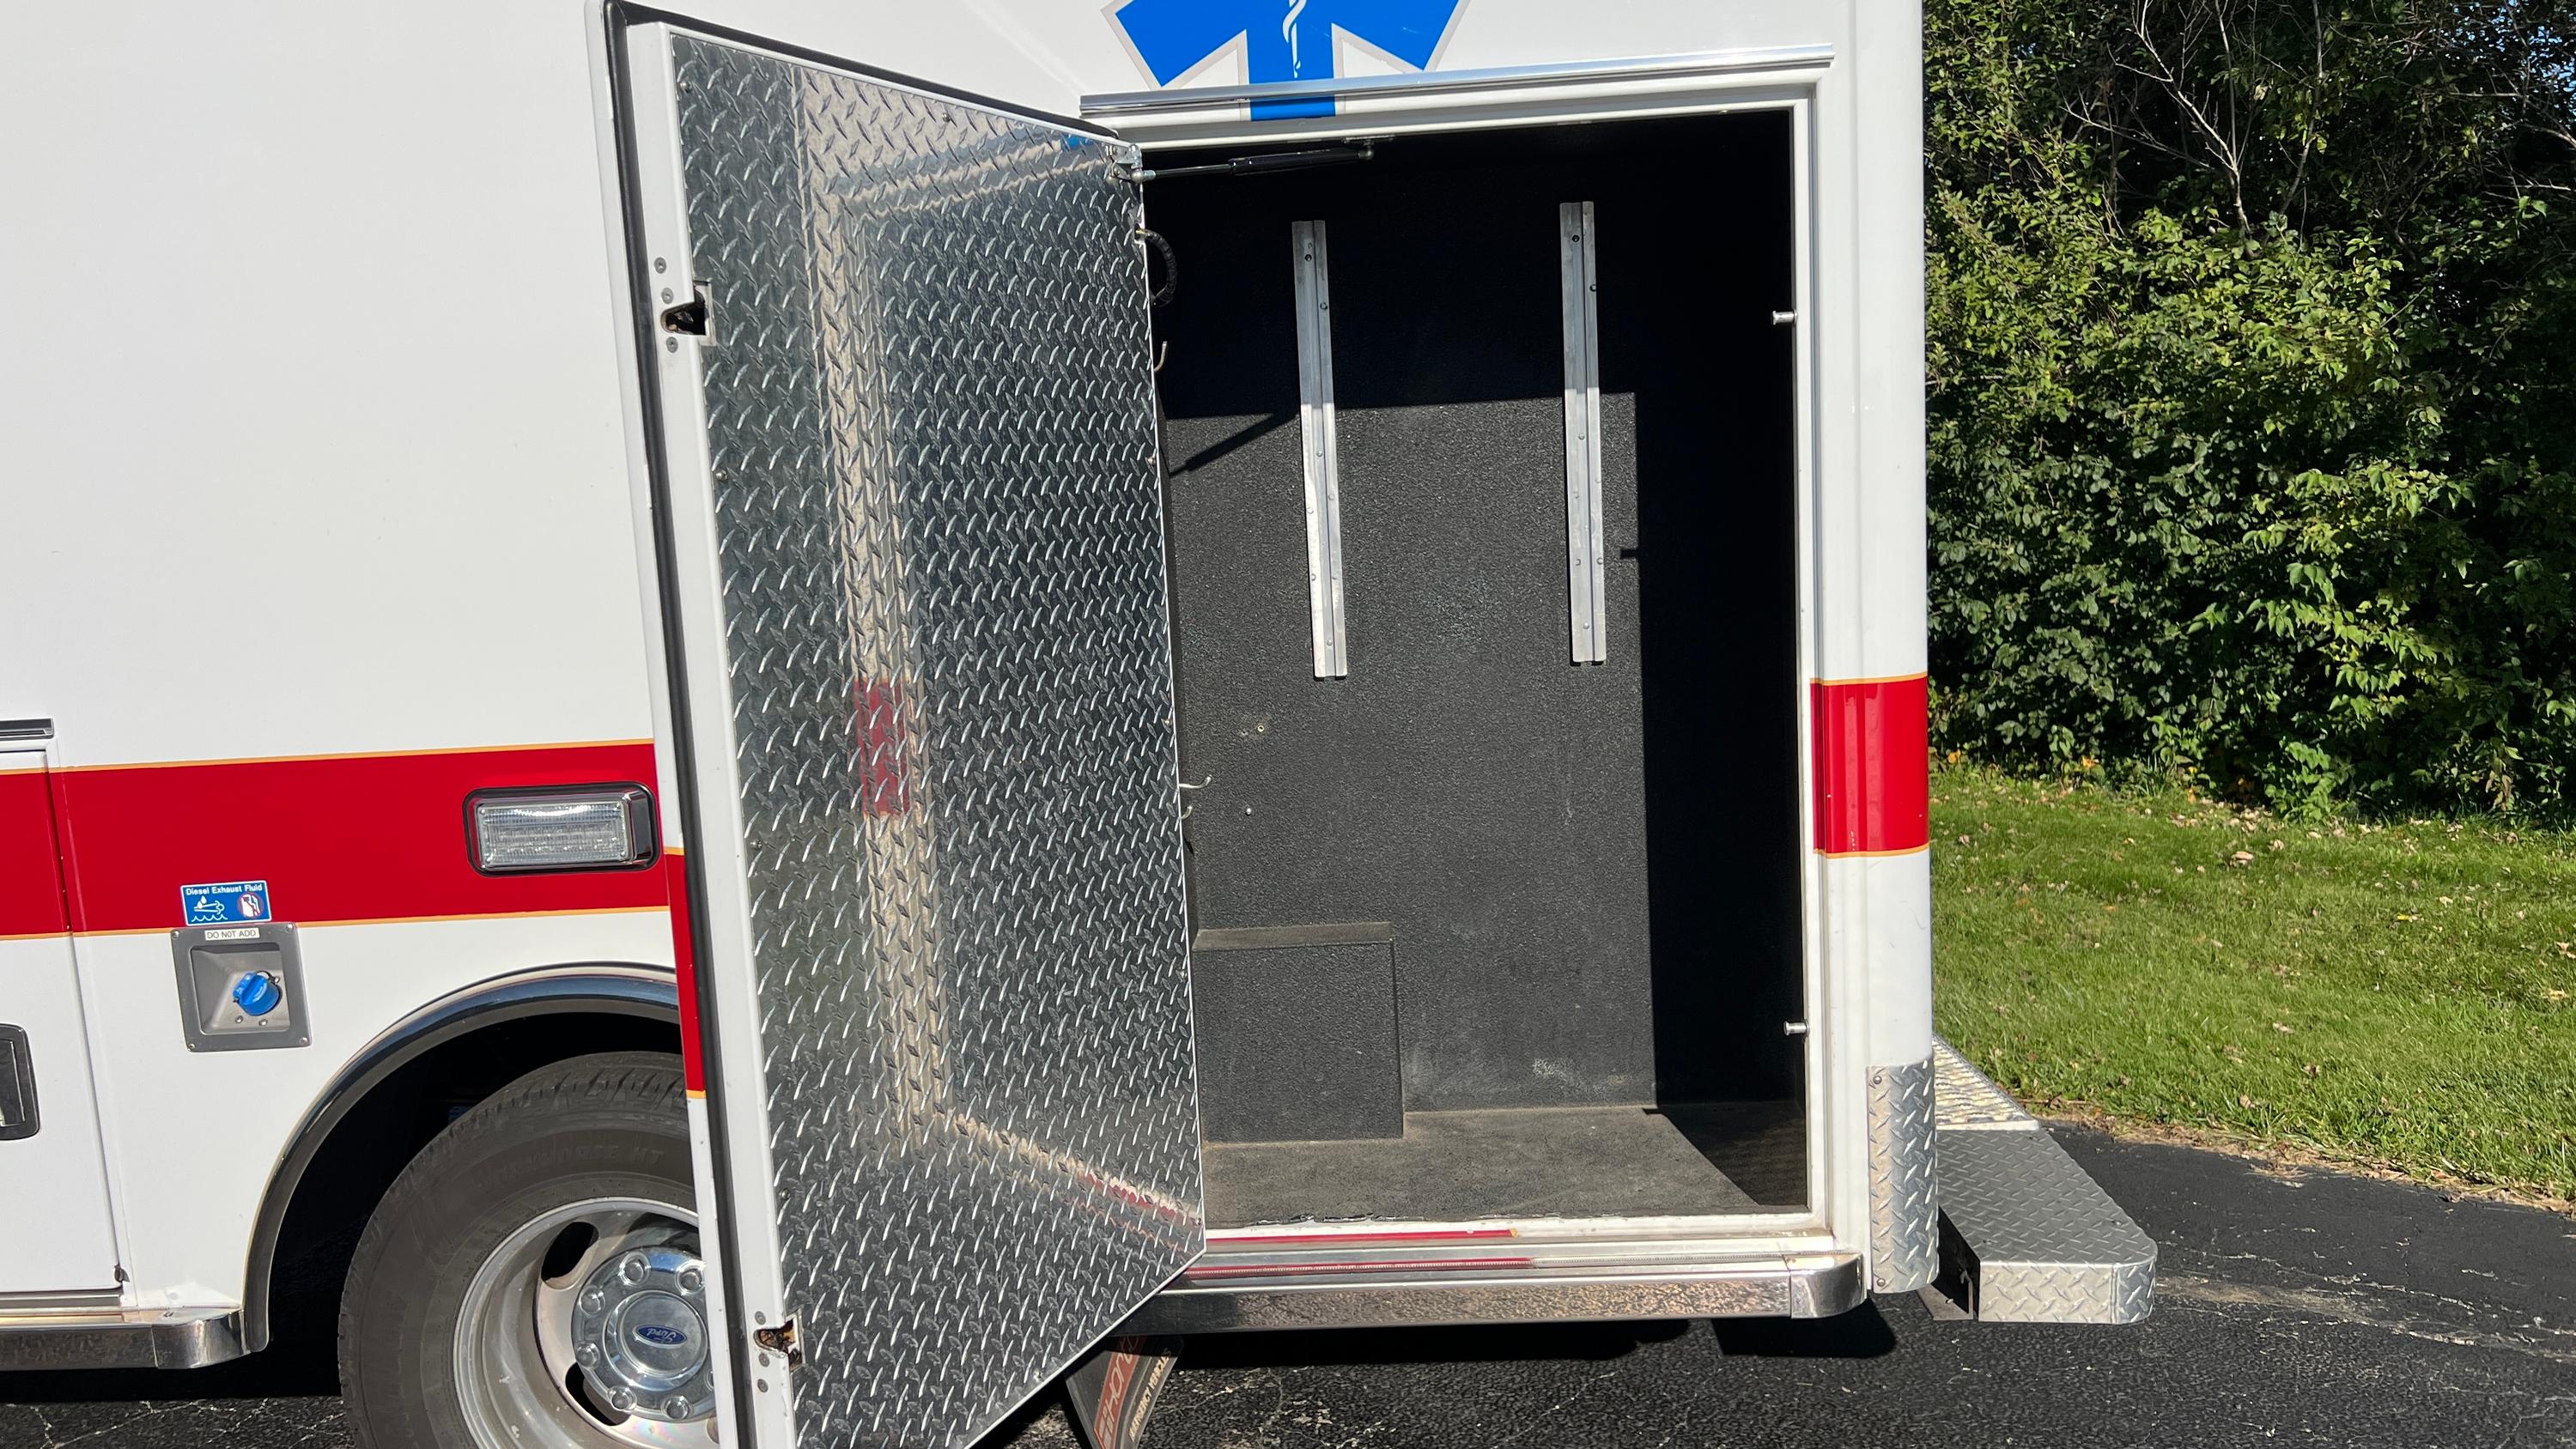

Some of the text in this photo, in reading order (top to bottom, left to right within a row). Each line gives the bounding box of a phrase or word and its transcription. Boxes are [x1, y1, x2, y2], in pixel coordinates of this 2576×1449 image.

[185, 883, 263, 895] Diesel Exhaust Fluid
[239, 929, 257, 937] ADD
[646, 1328, 677, 1343] Ford
